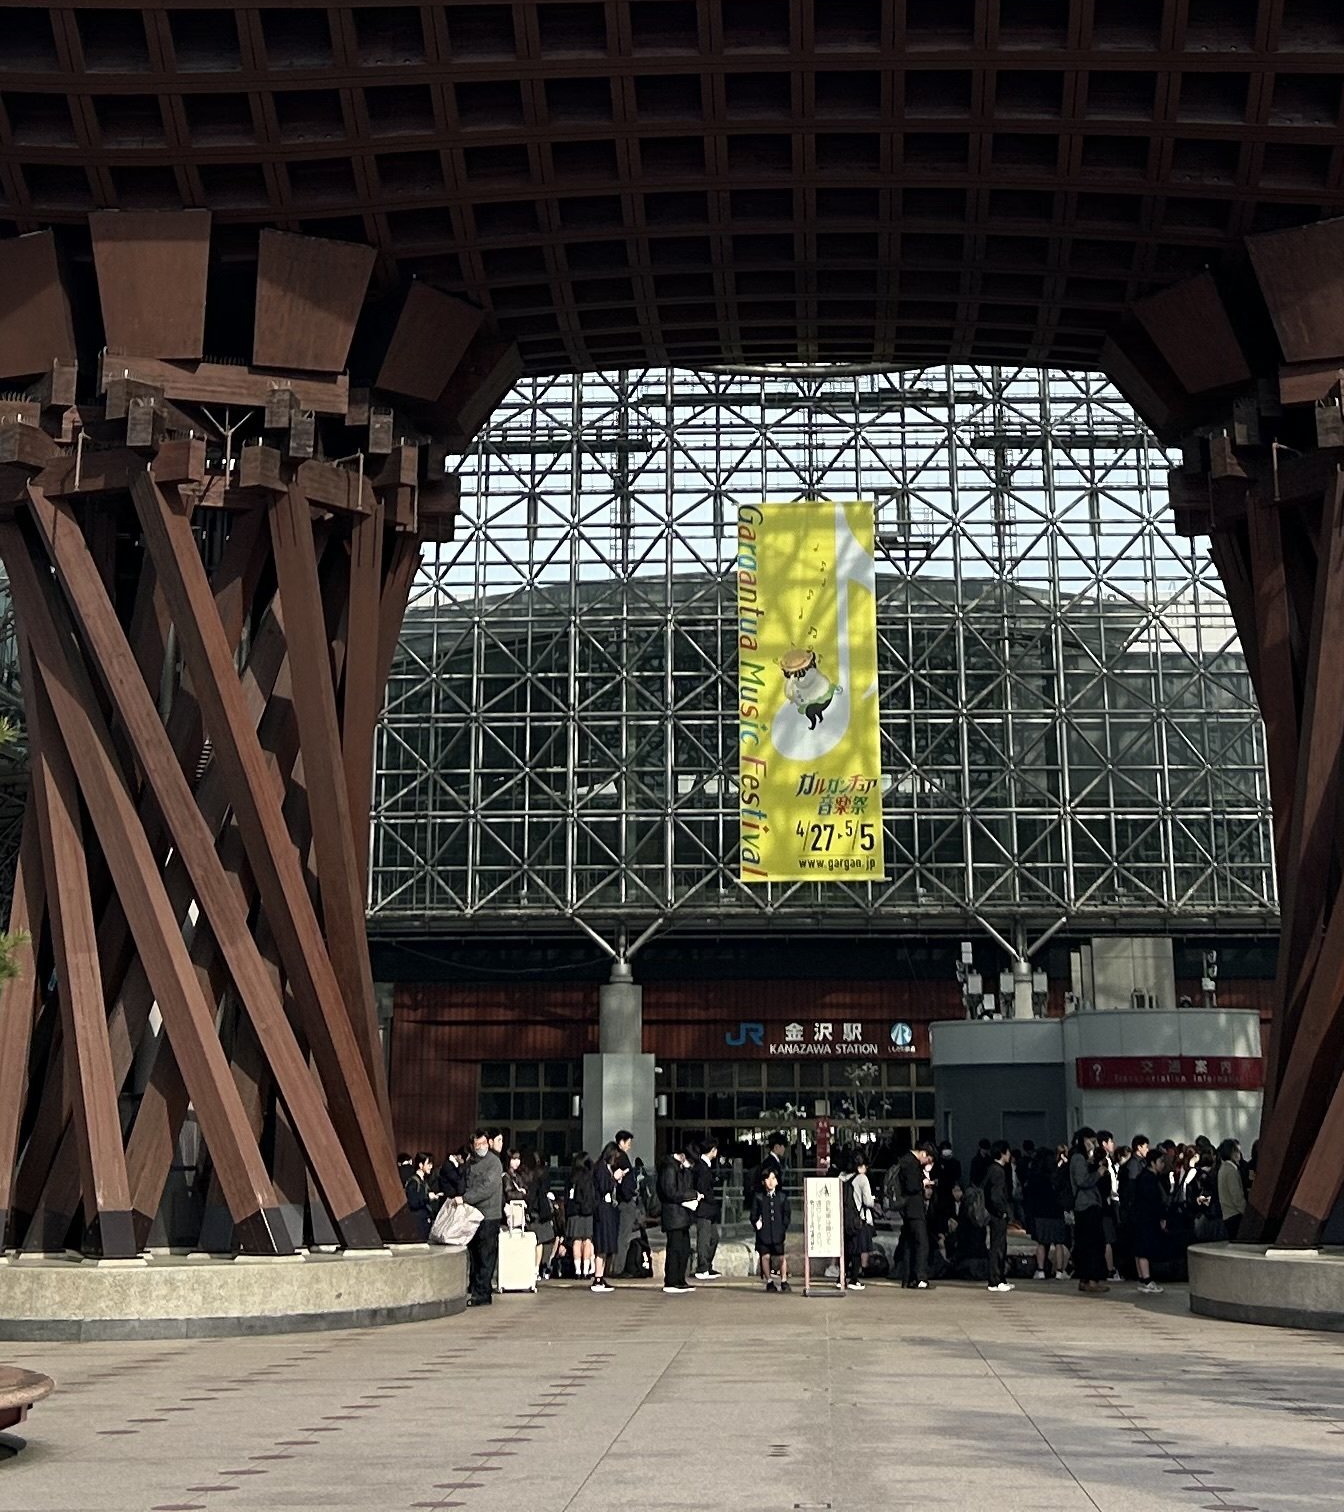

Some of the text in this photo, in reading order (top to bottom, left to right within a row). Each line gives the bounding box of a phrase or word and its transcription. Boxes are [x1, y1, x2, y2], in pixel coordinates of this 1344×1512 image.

[738, 504, 769, 877] Gargantua Music Festival
[796, 771, 878, 797] ガルガンチュア
[818, 794, 868, 815] 音楽祭
[799, 856, 876, 871] www.gargan.jp
[725, 1022, 764, 1046] JR
[784, 1022, 862, 1042] 金沢駅
[769, 1043, 832, 1054] KANAZAWA
[835, 1043, 878, 1054] STATION
